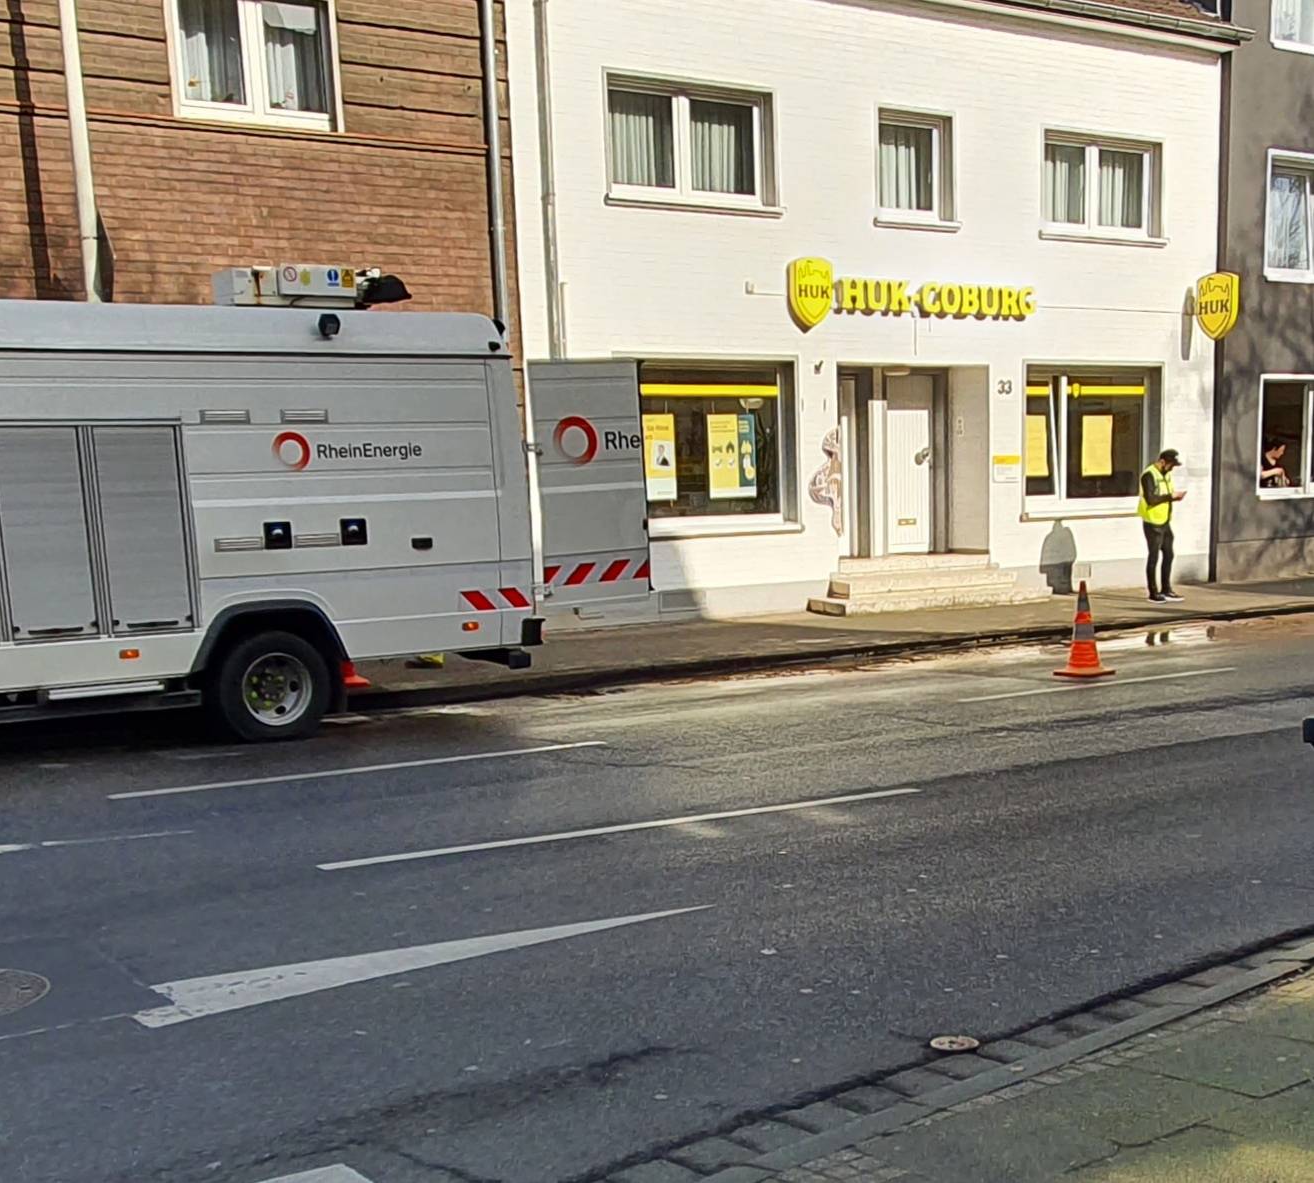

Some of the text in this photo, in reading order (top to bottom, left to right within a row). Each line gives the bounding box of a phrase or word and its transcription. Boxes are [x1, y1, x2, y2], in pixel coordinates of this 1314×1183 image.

[798, 276, 1036, 316] HUK HUK-COBURG
[1199, 299, 1229, 315] HUK
[997, 379, 1013, 395] 33
[316, 442, 423, 460] RheinEnergie
